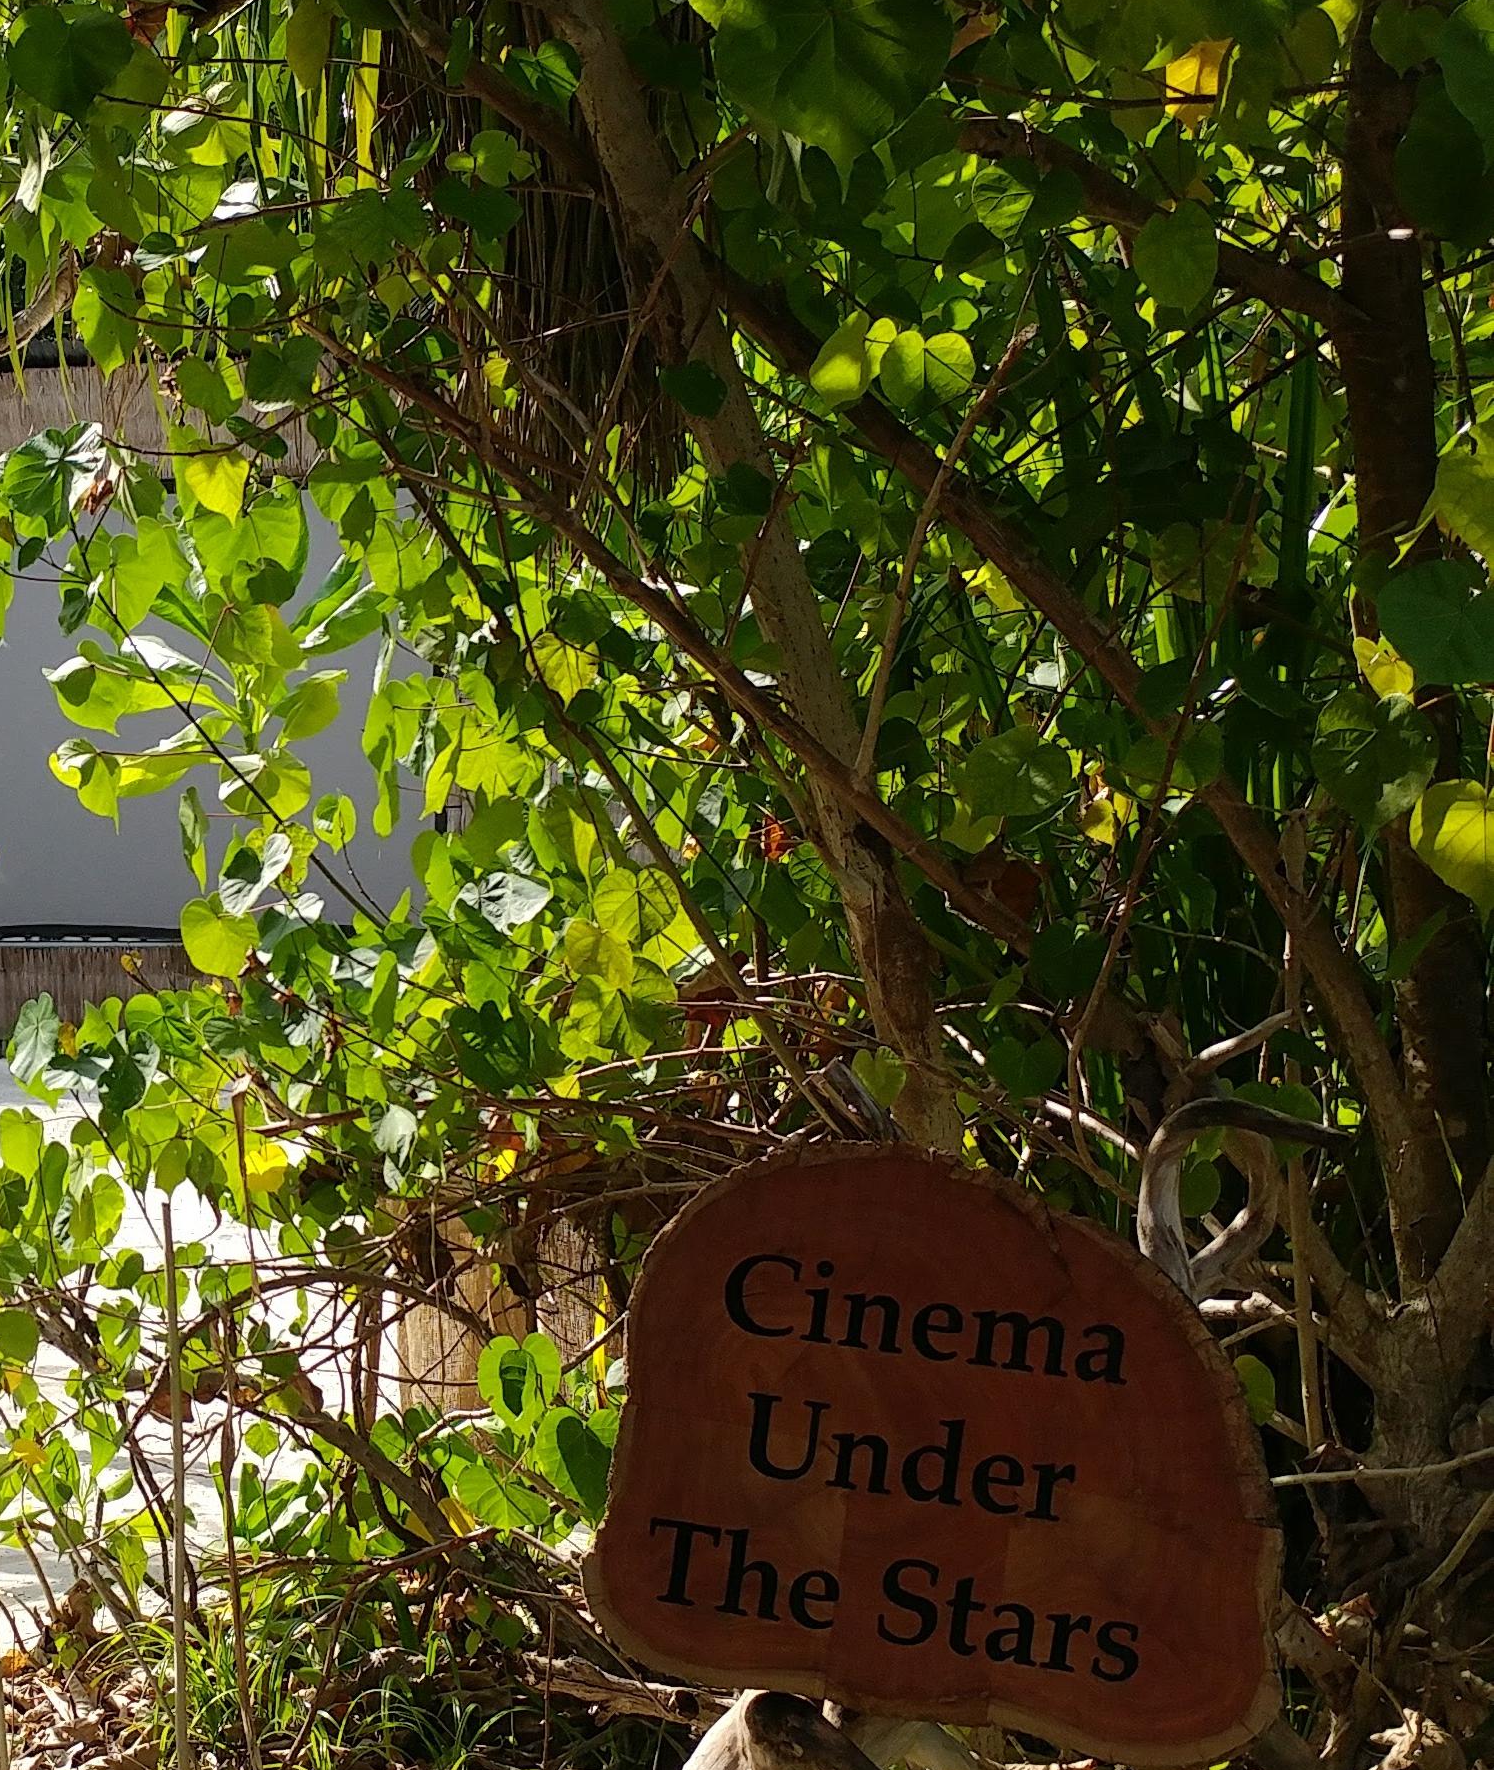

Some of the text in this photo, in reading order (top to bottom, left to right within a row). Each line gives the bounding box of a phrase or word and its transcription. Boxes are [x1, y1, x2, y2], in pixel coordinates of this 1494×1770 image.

[724, 1253, 1127, 1386] Cinema
[747, 1391, 1077, 1522] Under
[649, 1516, 1141, 1684] The Stars
